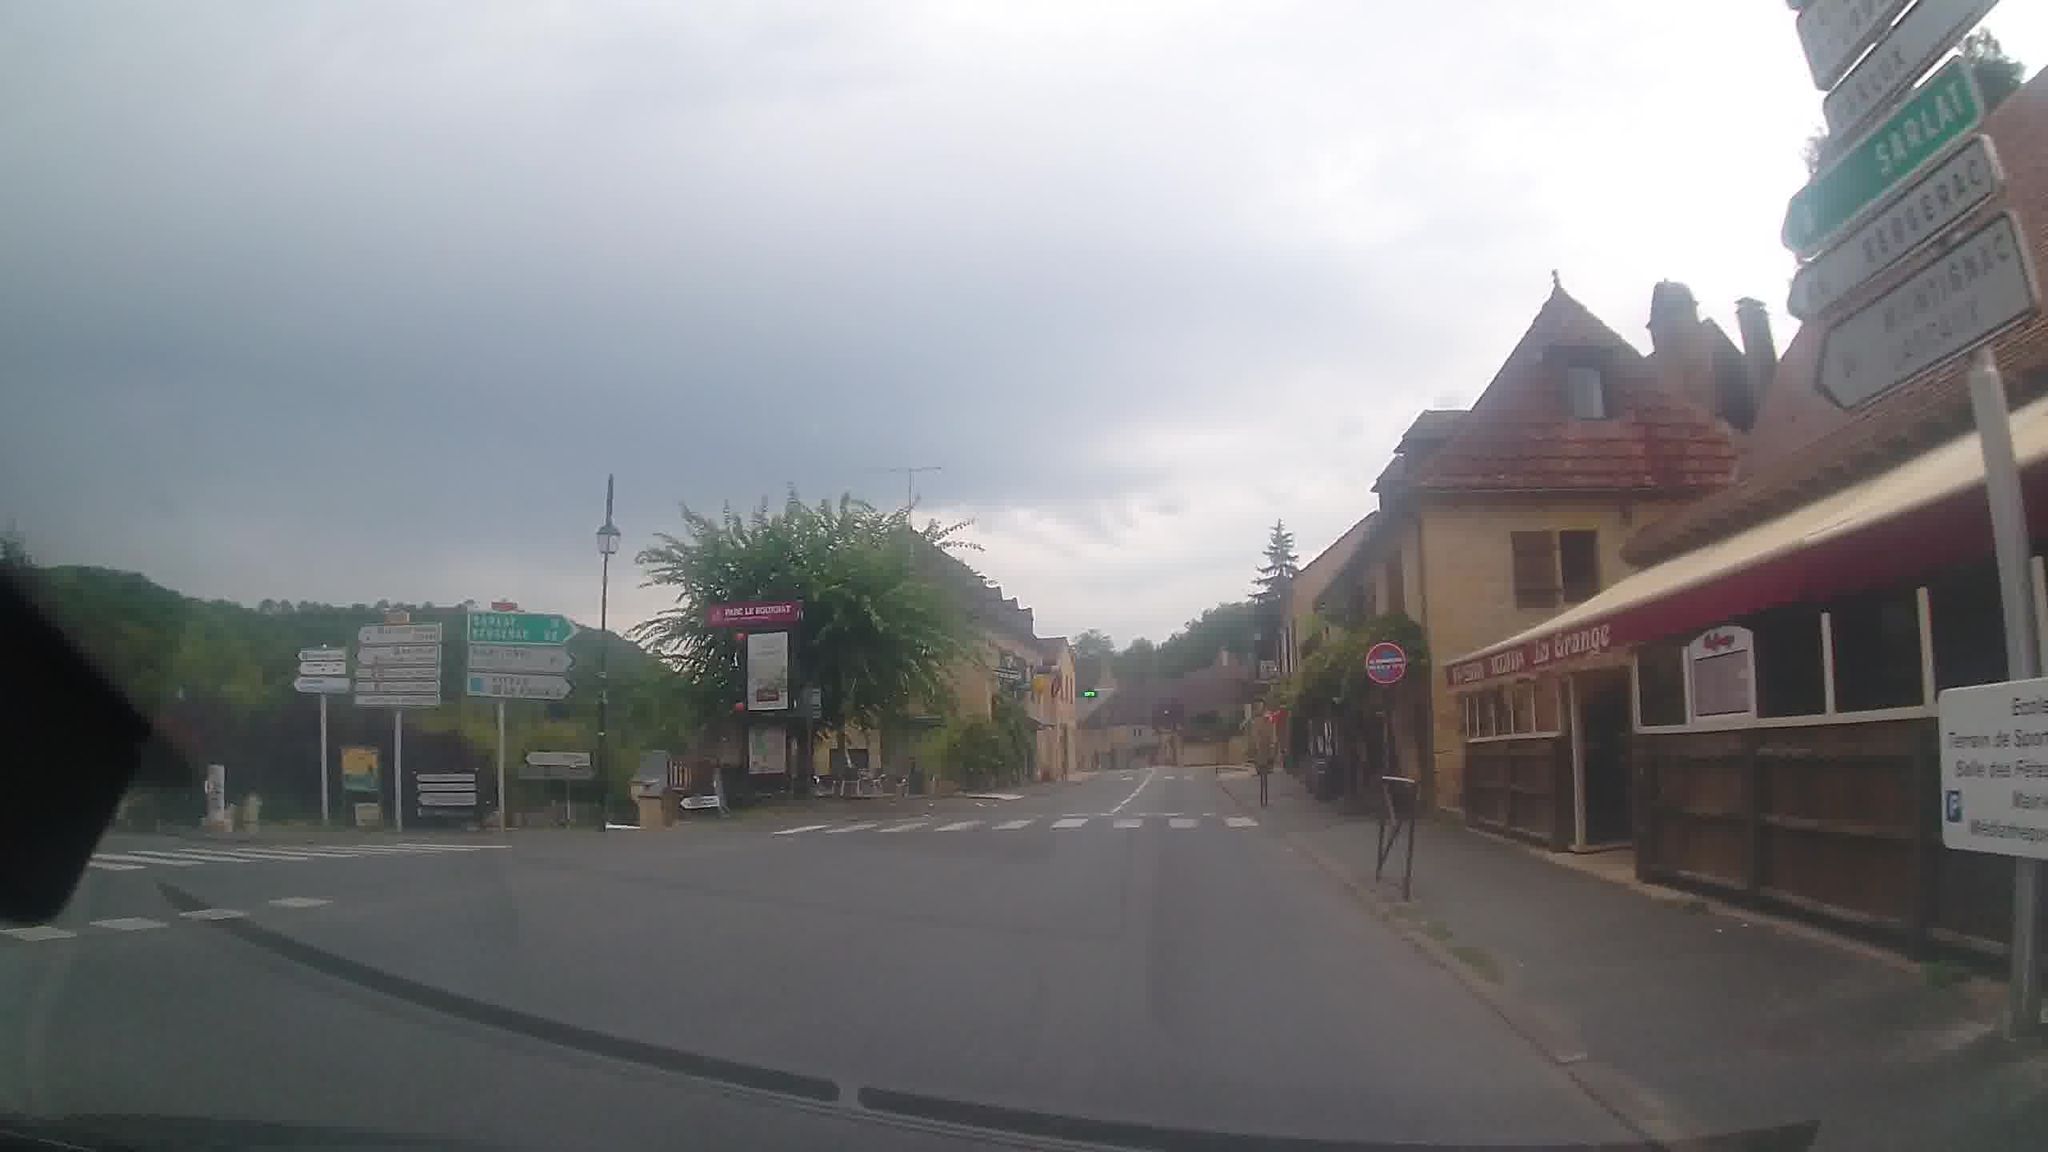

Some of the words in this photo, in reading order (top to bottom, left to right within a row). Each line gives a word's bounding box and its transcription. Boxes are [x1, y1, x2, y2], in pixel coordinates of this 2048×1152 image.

[1874, 82, 1966, 176] SARLAT
[745, 606, 755, 616] LE
[1554, 624, 1611, 657] Grange
[1948, 731, 1990, 749] Terrain
[1991, 730, 2010, 748] de
[1955, 758, 1985, 778] Salle
[1989, 759, 2011, 778] des
